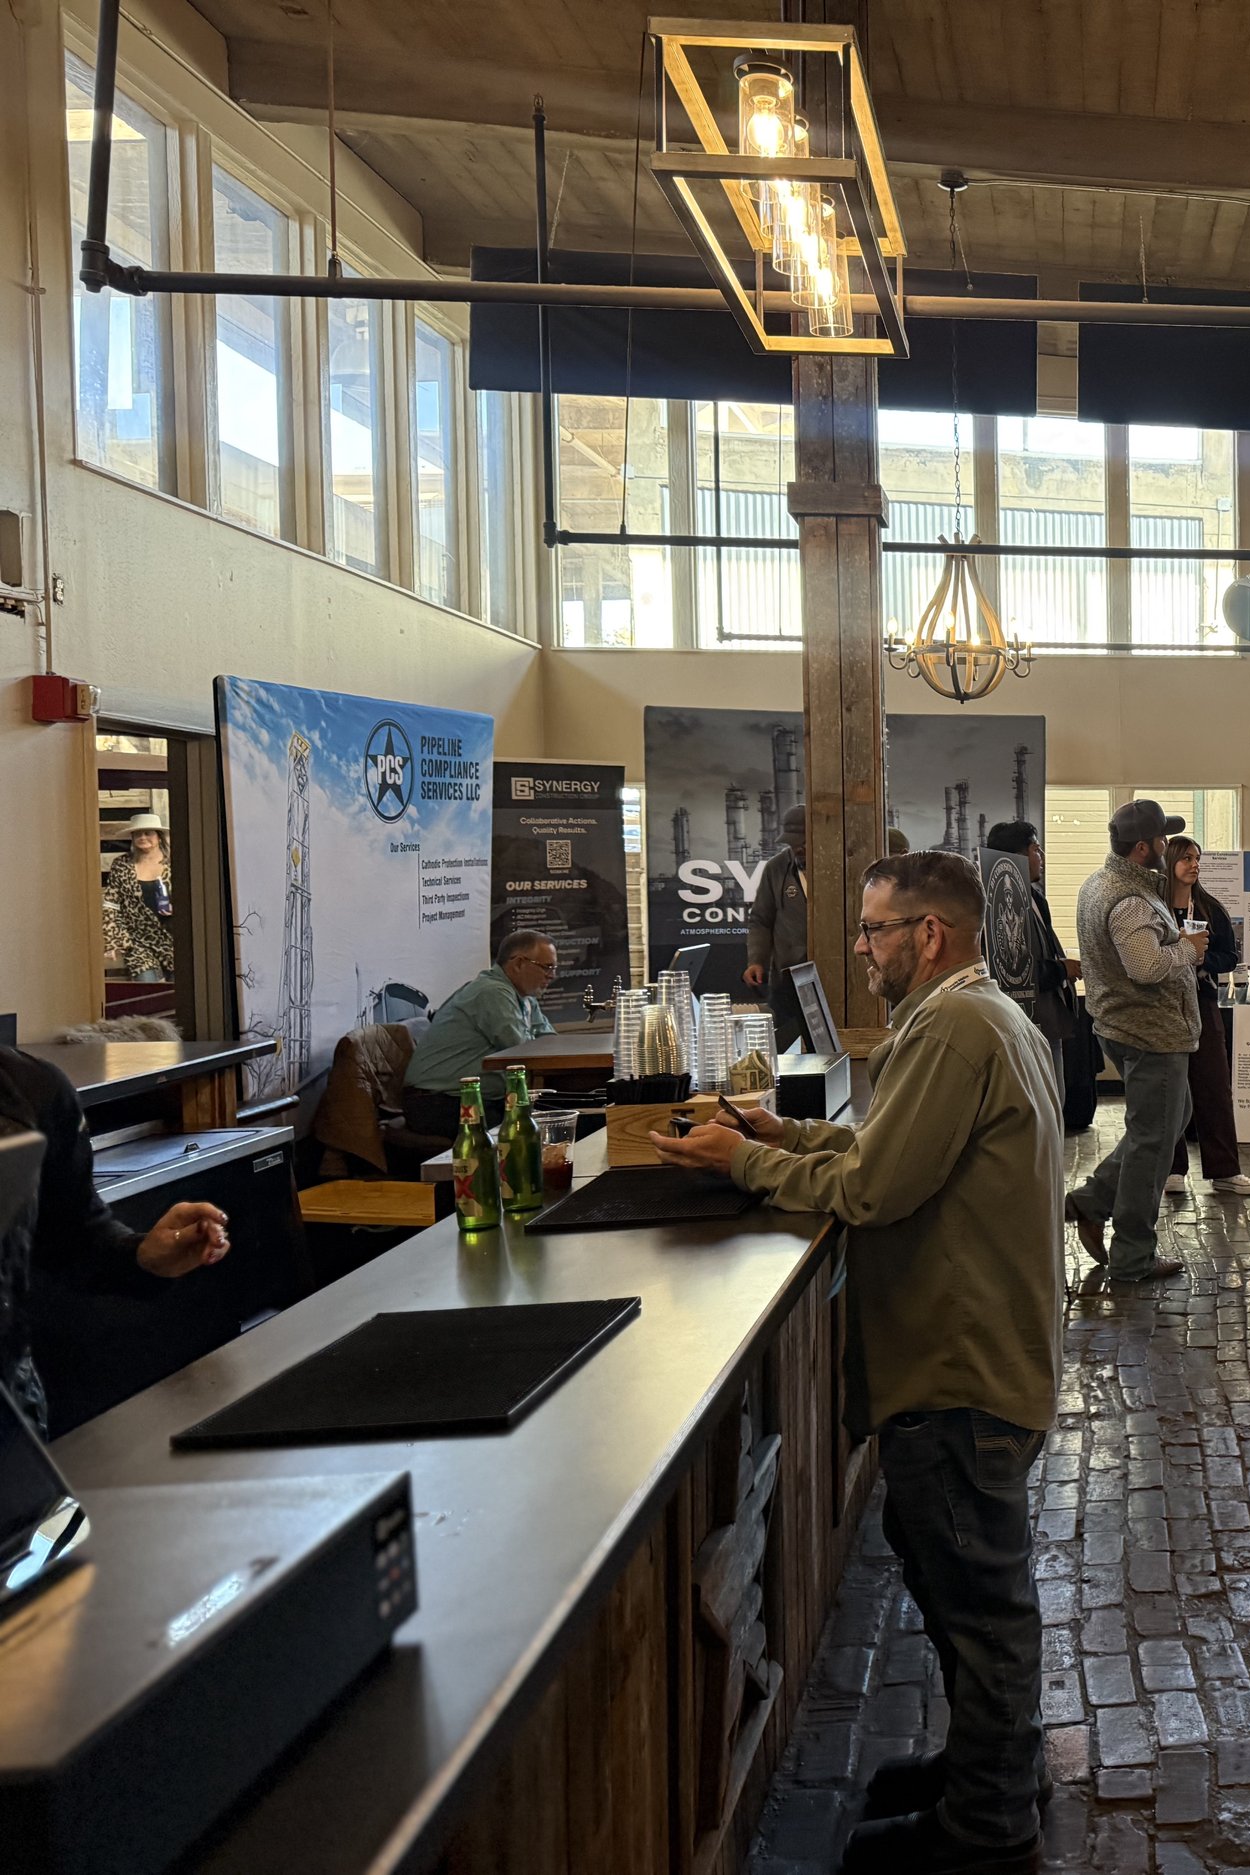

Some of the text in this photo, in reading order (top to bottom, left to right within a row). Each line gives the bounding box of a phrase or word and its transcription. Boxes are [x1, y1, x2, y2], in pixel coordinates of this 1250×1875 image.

[420, 735, 463, 758] PIPELINE
[377, 754, 404, 785] PCS
[420, 758, 480, 780] COMPLIANCE
[420, 780, 481, 801] SERVICES LLC
[534, 779, 601, 793] SYNERGY
[390, 842, 420, 853] Our Services
[505, 880, 589, 891] OUR SERVICES
[677, 859, 769, 904] SY
